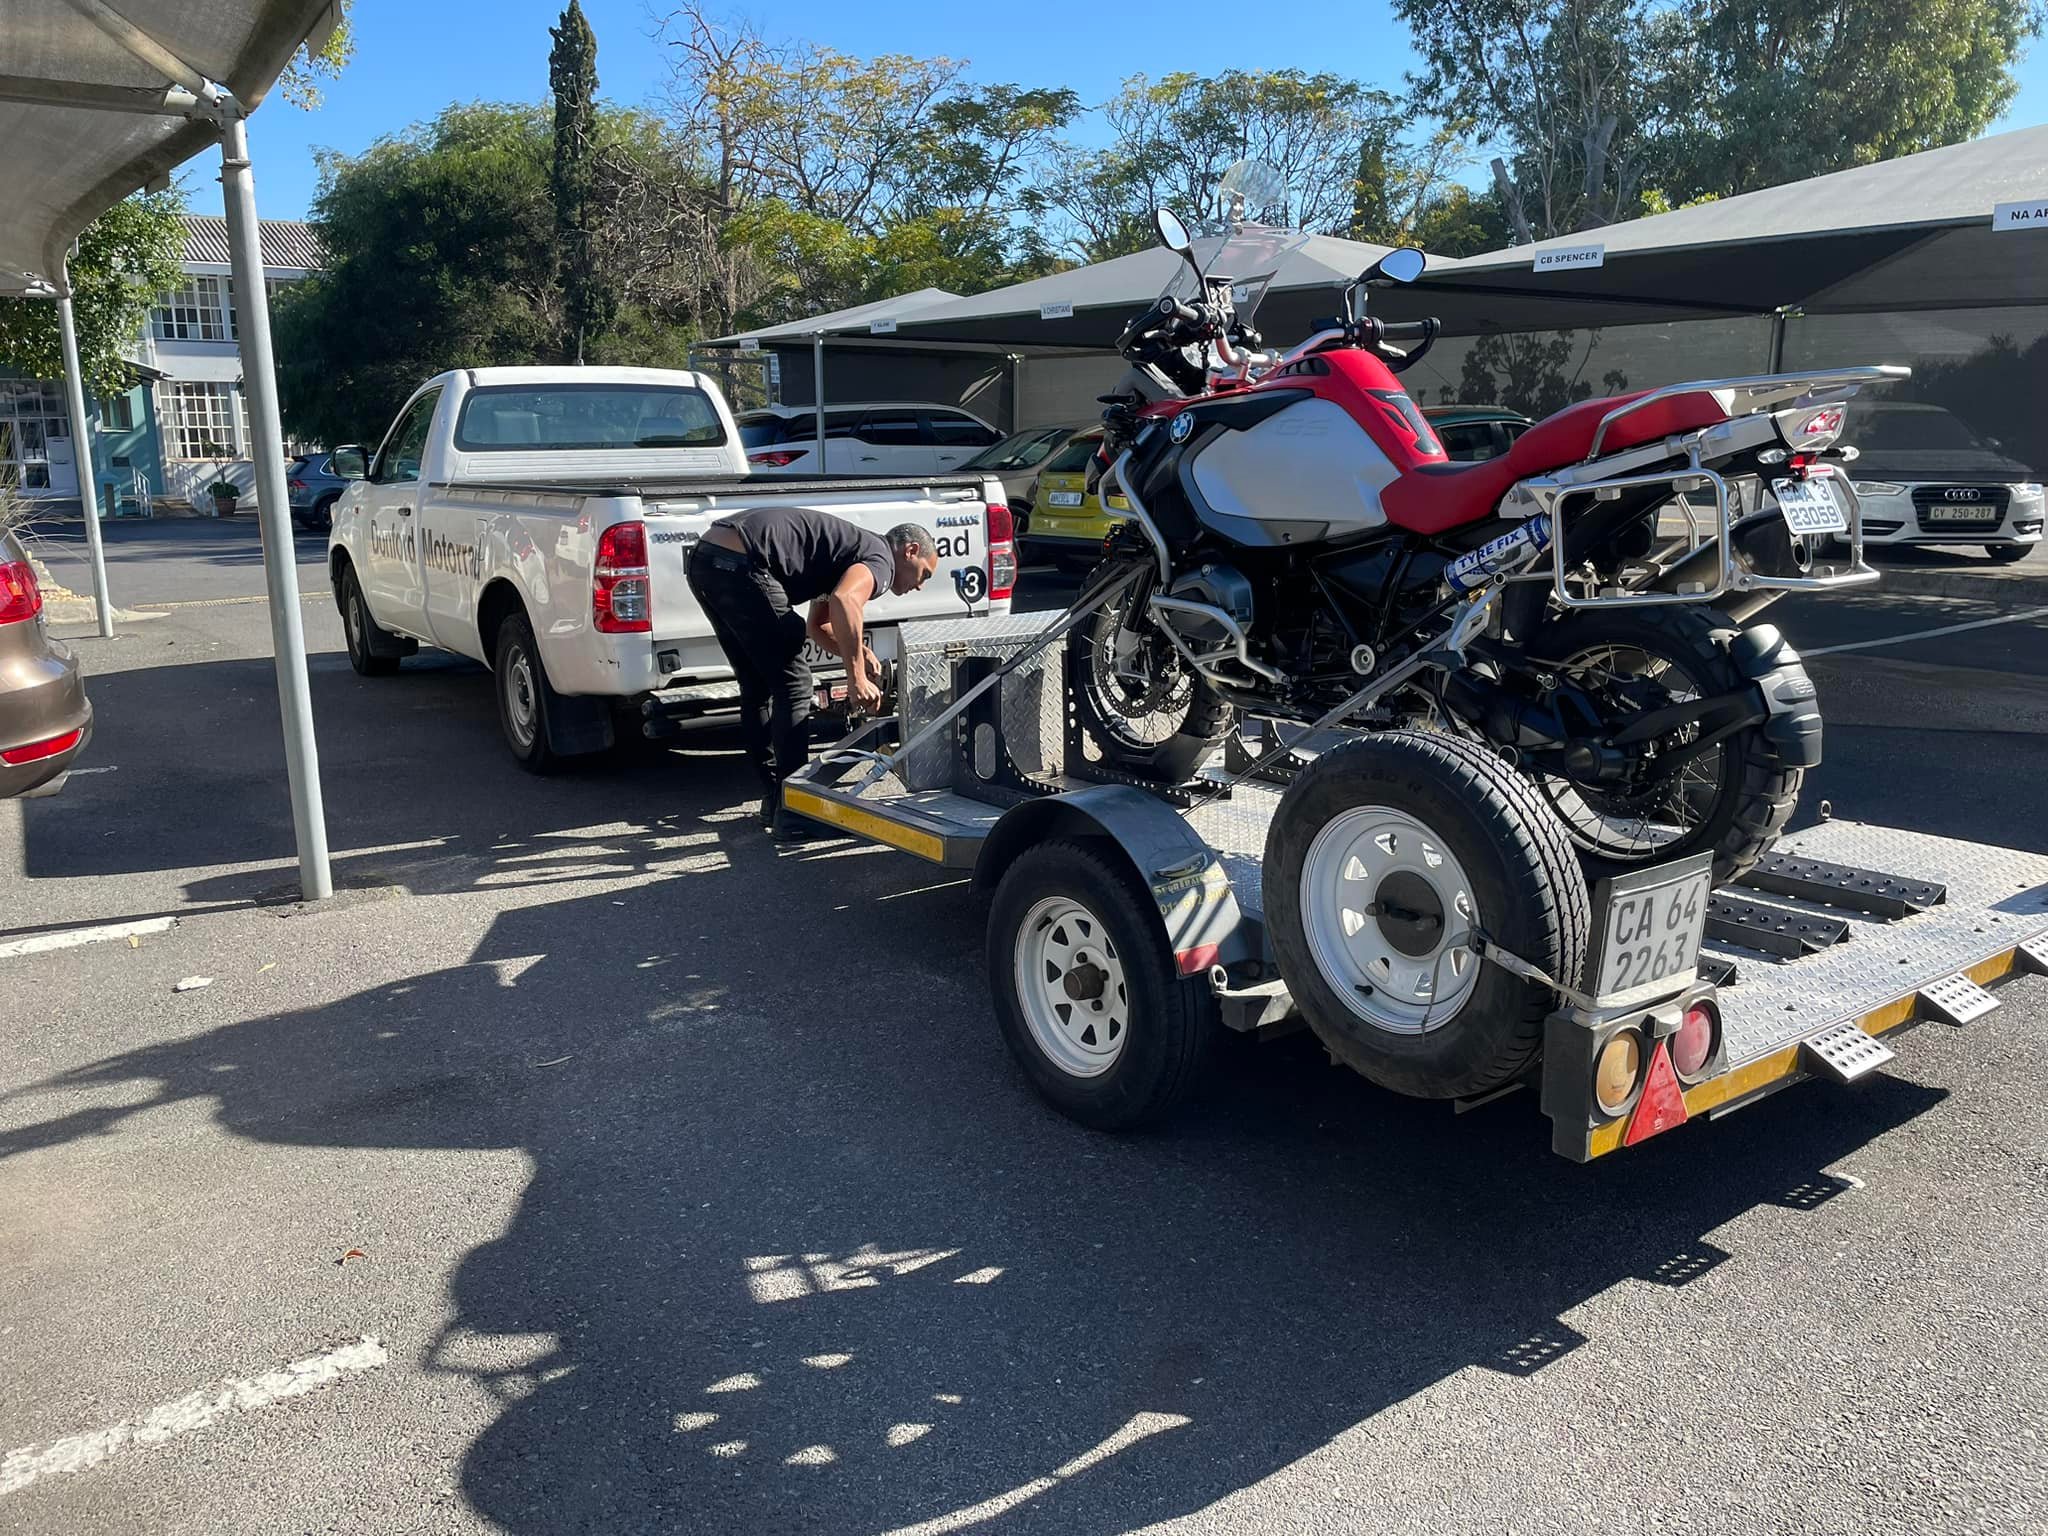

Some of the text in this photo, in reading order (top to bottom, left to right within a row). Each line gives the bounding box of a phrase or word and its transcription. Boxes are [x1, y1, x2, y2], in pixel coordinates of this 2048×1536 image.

[2011, 210, 2029, 220] NA
[1541, 251, 1598, 264] CB SPENCER
[1780, 483, 1830, 503] CAA 3
[1789, 505, 1840, 526] 23059
[1952, 508, 1991, 519] 250-287
[1459, 542, 1494, 569] TYRE
[1496, 530, 1520, 551] FIX
[1615, 881, 1701, 946] CA 64
[1610, 931, 1689, 994] 2263
